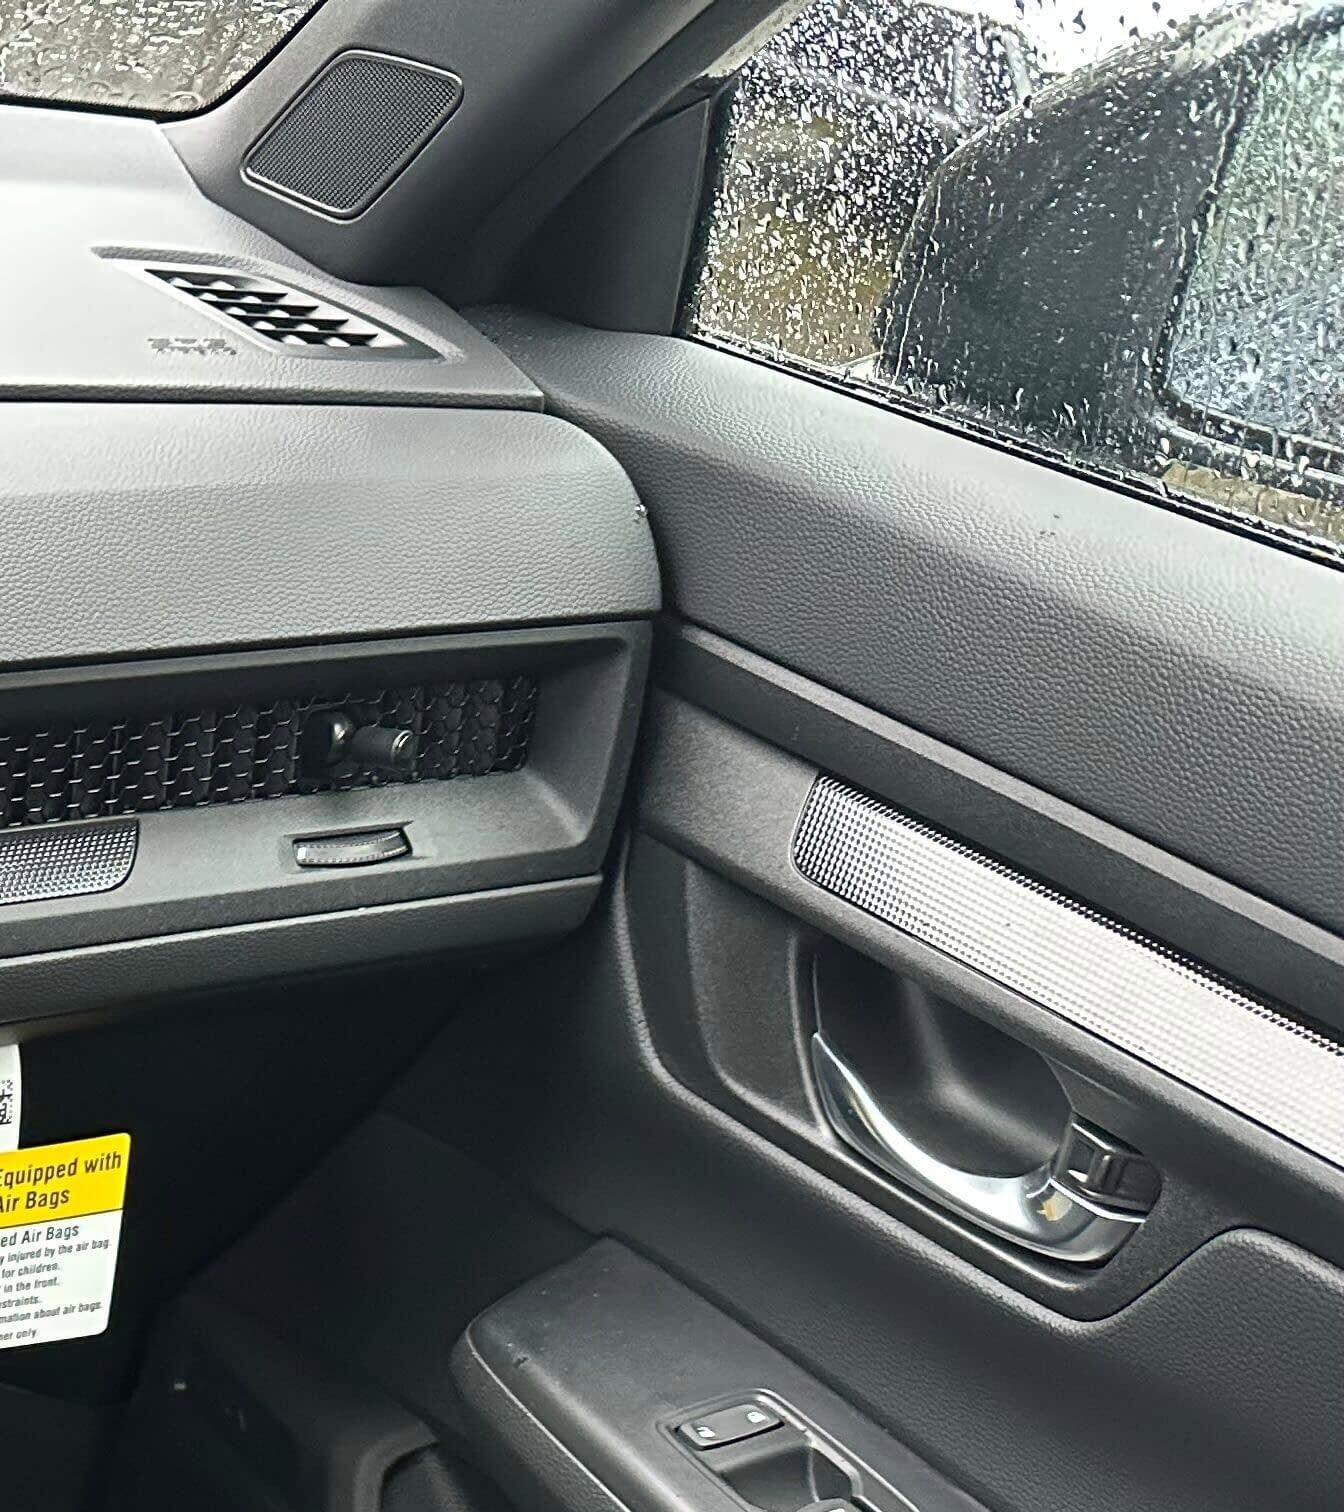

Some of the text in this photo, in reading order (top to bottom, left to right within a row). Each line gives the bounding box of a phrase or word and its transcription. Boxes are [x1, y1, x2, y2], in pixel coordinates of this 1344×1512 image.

[84, 1150, 123, 1175] with
[25, 1188, 71, 1210] Bags
[20, 1229, 43, 1245] Air
[46, 1224, 80, 1241] Bags
[7, 1247, 42, 1264] injured
[44, 1245, 56, 1259] by
[57, 1243, 73, 1256] the
[75, 1240, 90, 1253] air
[1, 1267, 15, 1280] for
[3, 1282, 13, 1294] in
[15, 1280, 32, 1292] the
[33, 1306, 61, 1320] about
[62, 1304, 77, 1316] air
